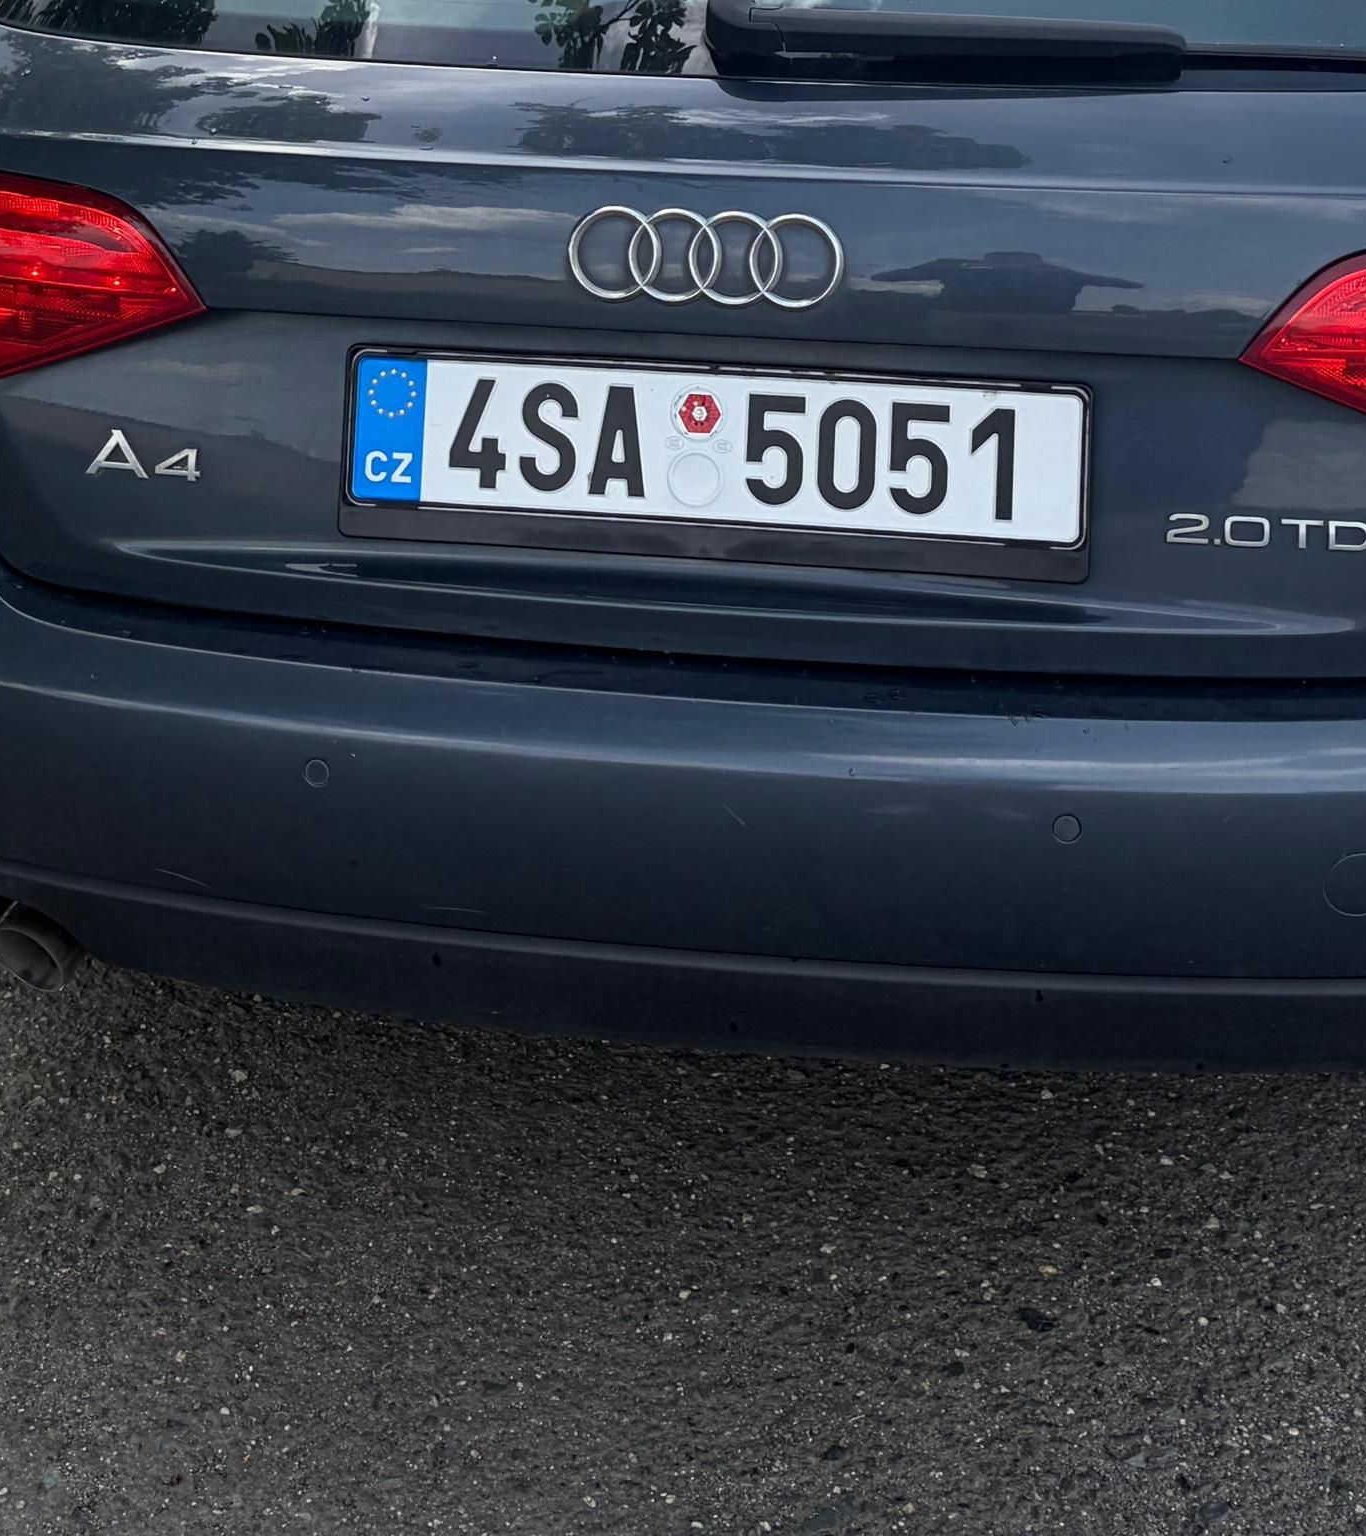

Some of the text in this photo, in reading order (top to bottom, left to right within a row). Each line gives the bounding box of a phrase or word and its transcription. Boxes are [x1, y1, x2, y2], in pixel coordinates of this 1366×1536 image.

[85, 429, 201, 482] A4
[364, 450, 413, 483] CZ
[448, 378, 1017, 522] 4SA 5051
[1166, 513, 1271, 547] 2.0
